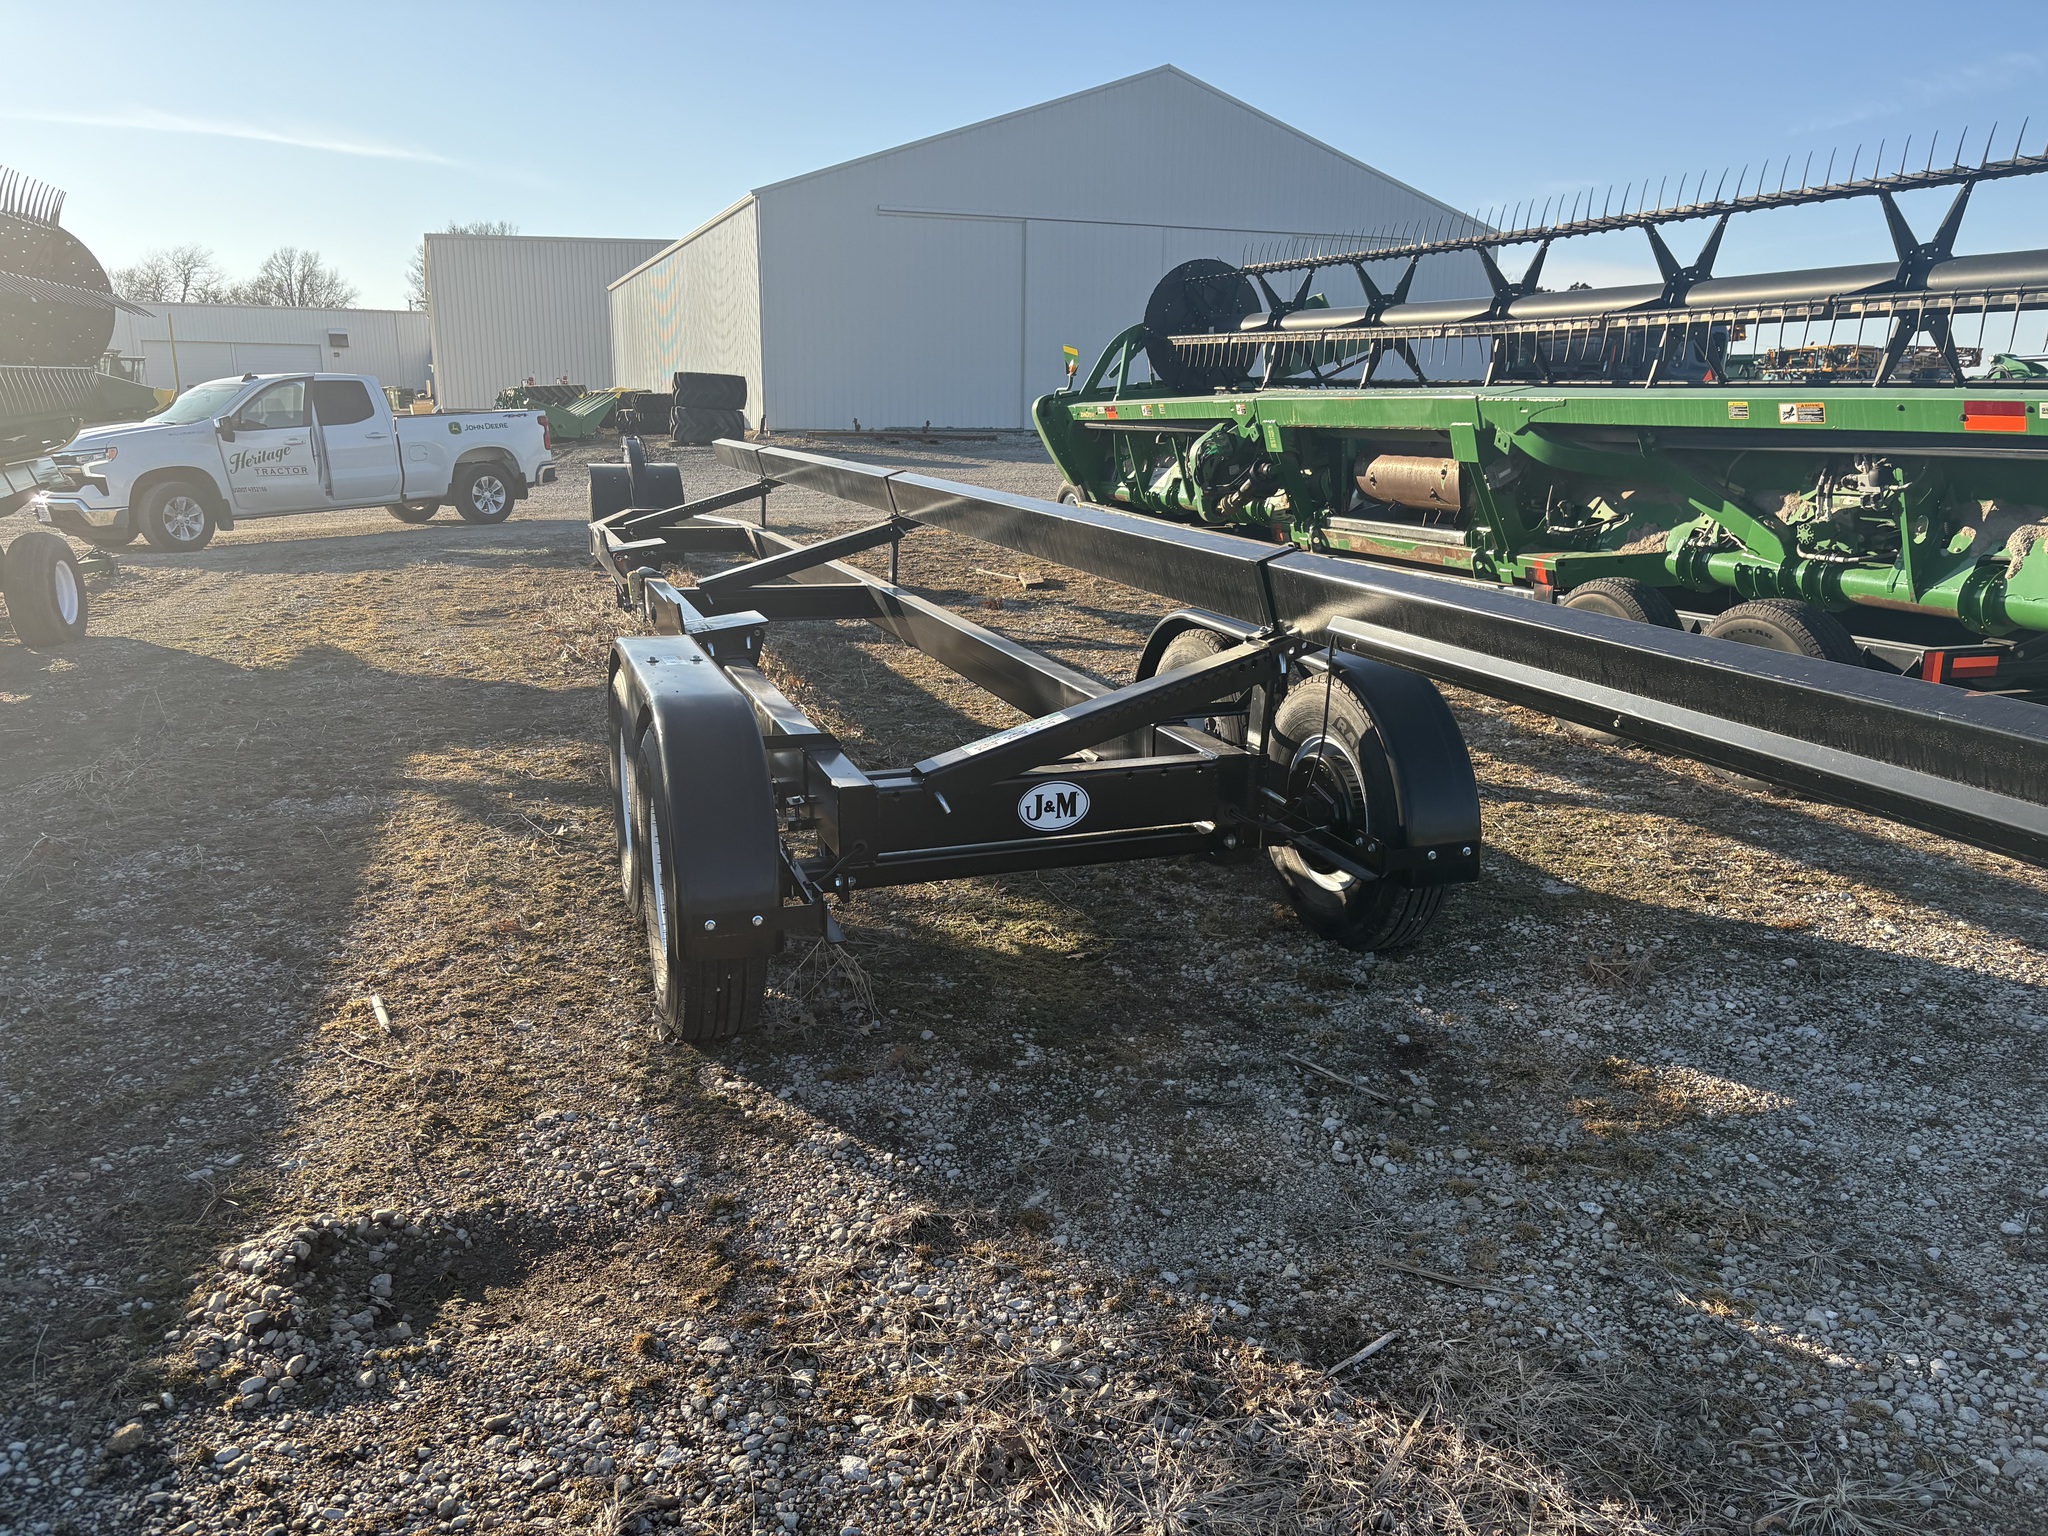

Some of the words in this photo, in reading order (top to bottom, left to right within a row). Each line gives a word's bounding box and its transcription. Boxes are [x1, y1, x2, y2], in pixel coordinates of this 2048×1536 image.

[484, 422, 509, 430] DEERE
[229, 446, 291, 475] Heritage
[254, 467, 308, 475] TRACTOR
[1025, 791, 1078, 821] J&M
